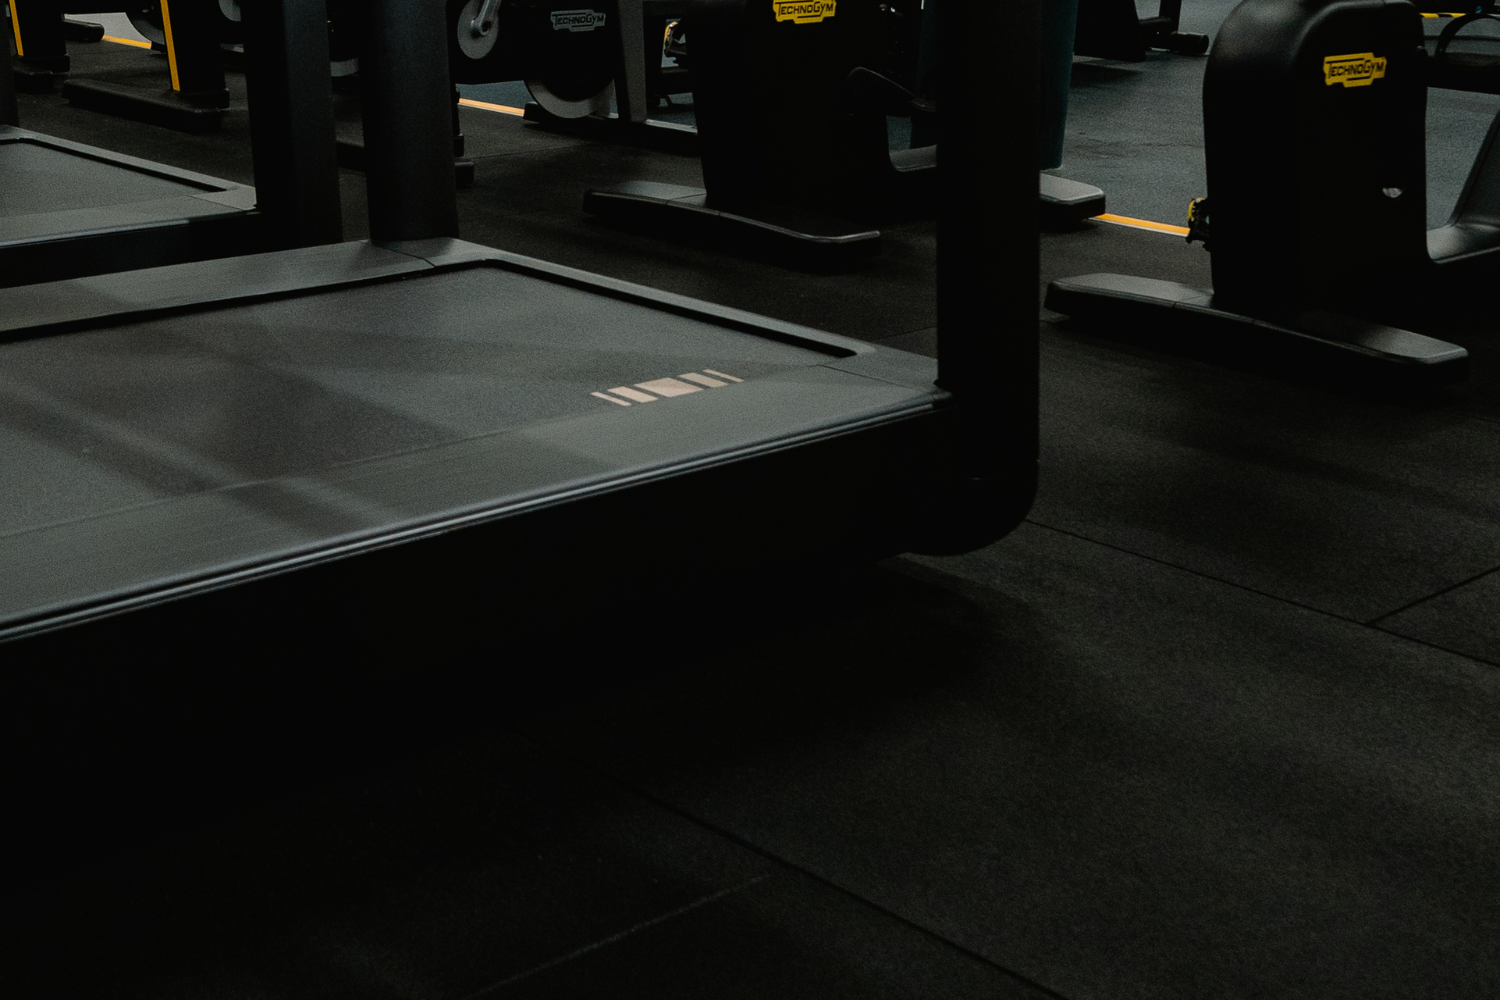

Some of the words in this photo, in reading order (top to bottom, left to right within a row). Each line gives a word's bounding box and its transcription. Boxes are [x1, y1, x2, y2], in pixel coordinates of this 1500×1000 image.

[775, 0, 834, 19] TECHNOGYM
[552, 12, 605, 28] TECHNOGYM
[1325, 56, 1385, 81] TECHNOGYM
